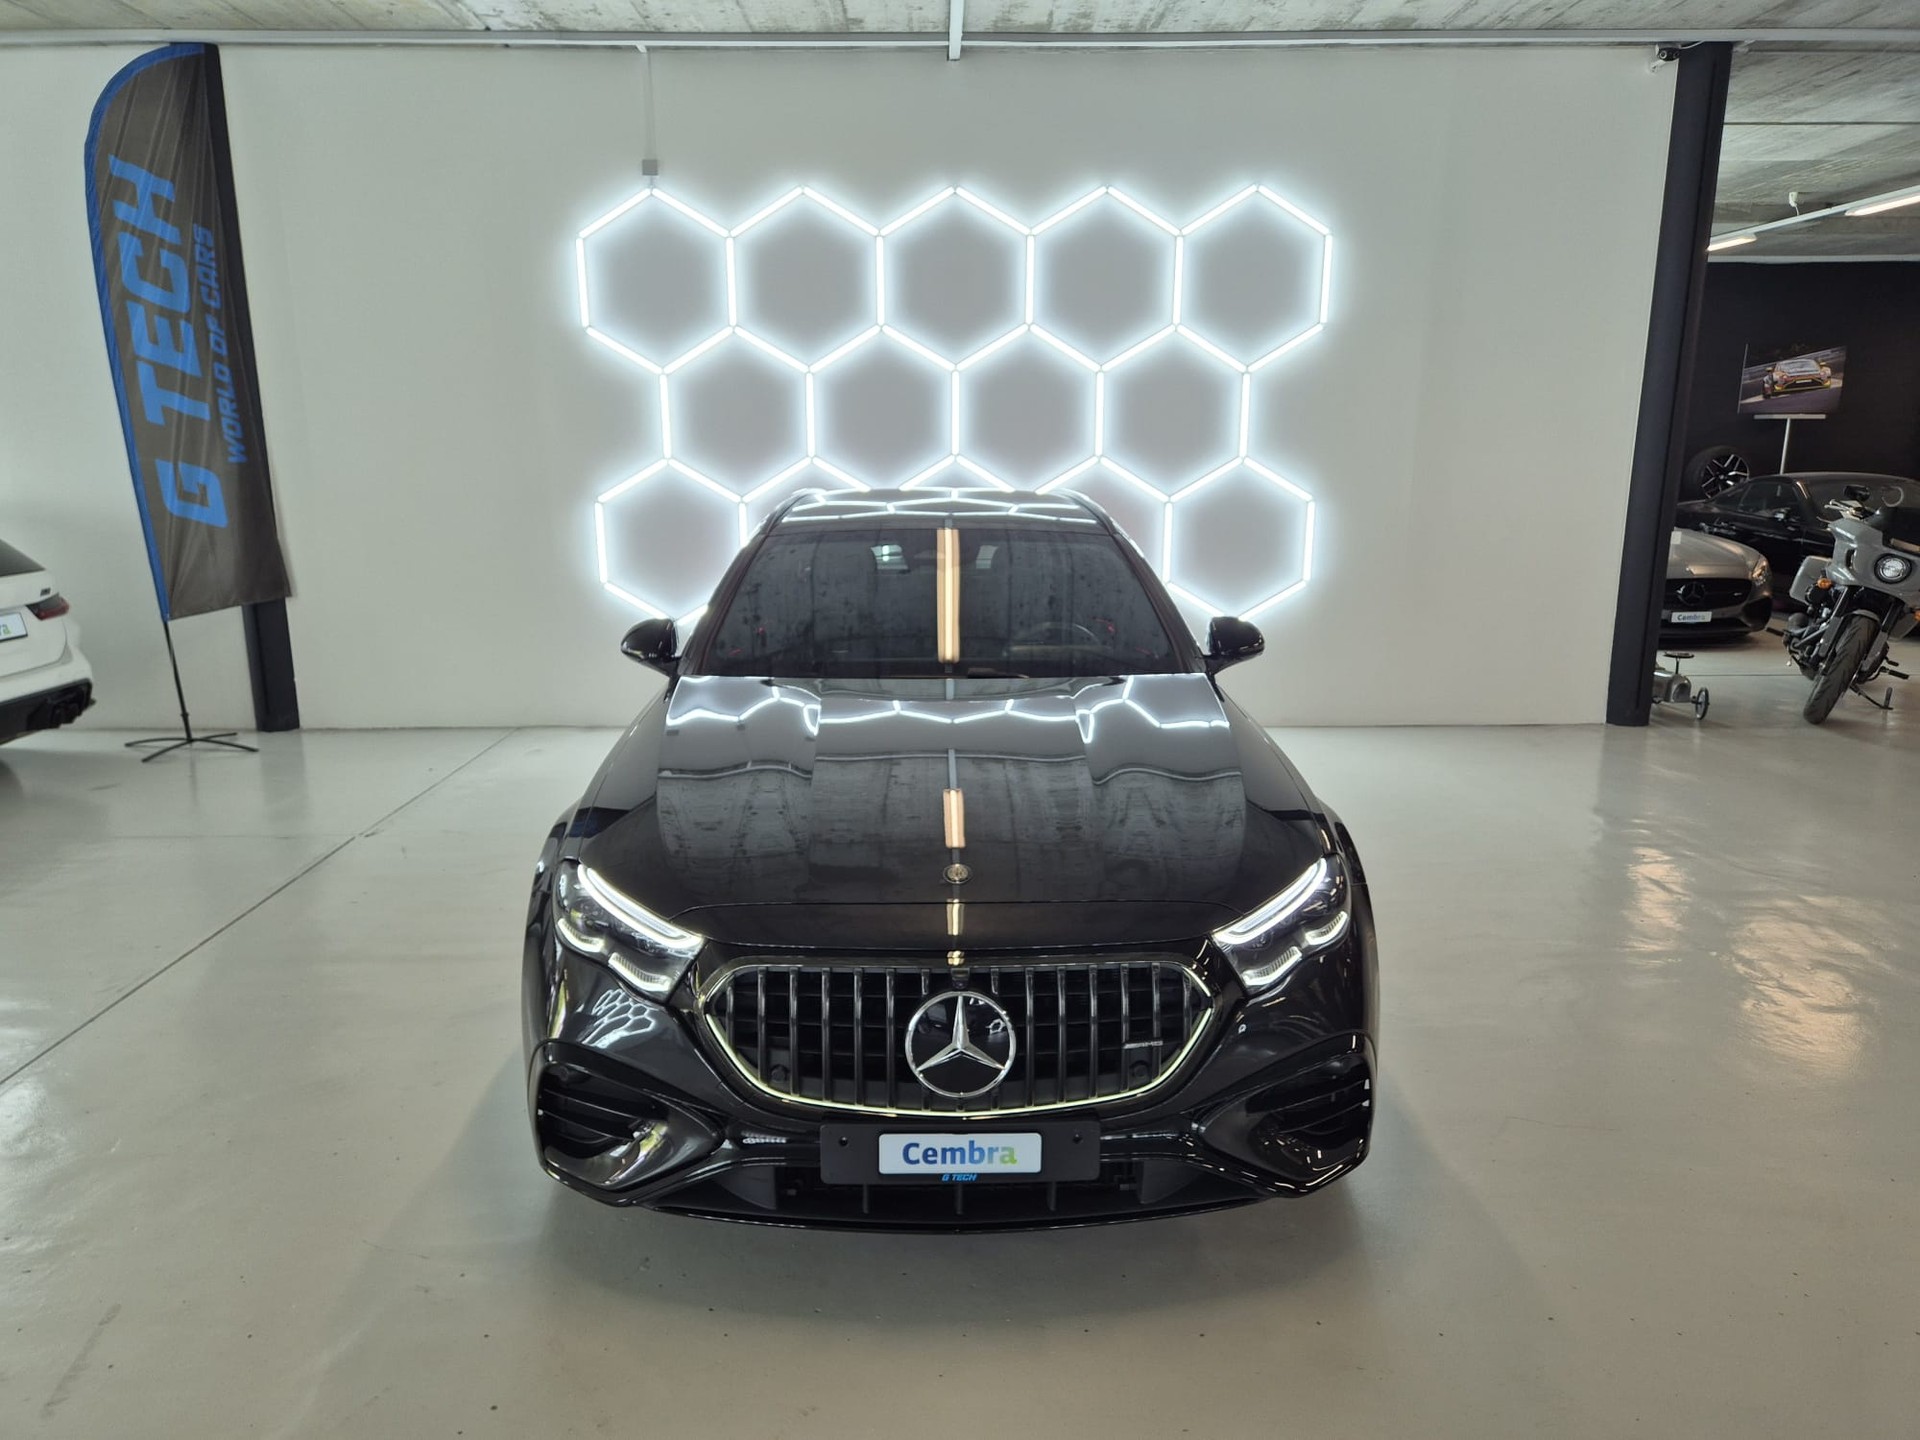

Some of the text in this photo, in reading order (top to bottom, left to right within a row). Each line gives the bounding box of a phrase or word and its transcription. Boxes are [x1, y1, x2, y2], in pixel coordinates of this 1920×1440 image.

[108, 154, 229, 529] G TECH
[193, 223, 248, 463] WORLD OF CARS
[902, 1140, 1017, 1165] Cembra
[951, 1173, 978, 1182] TECH
